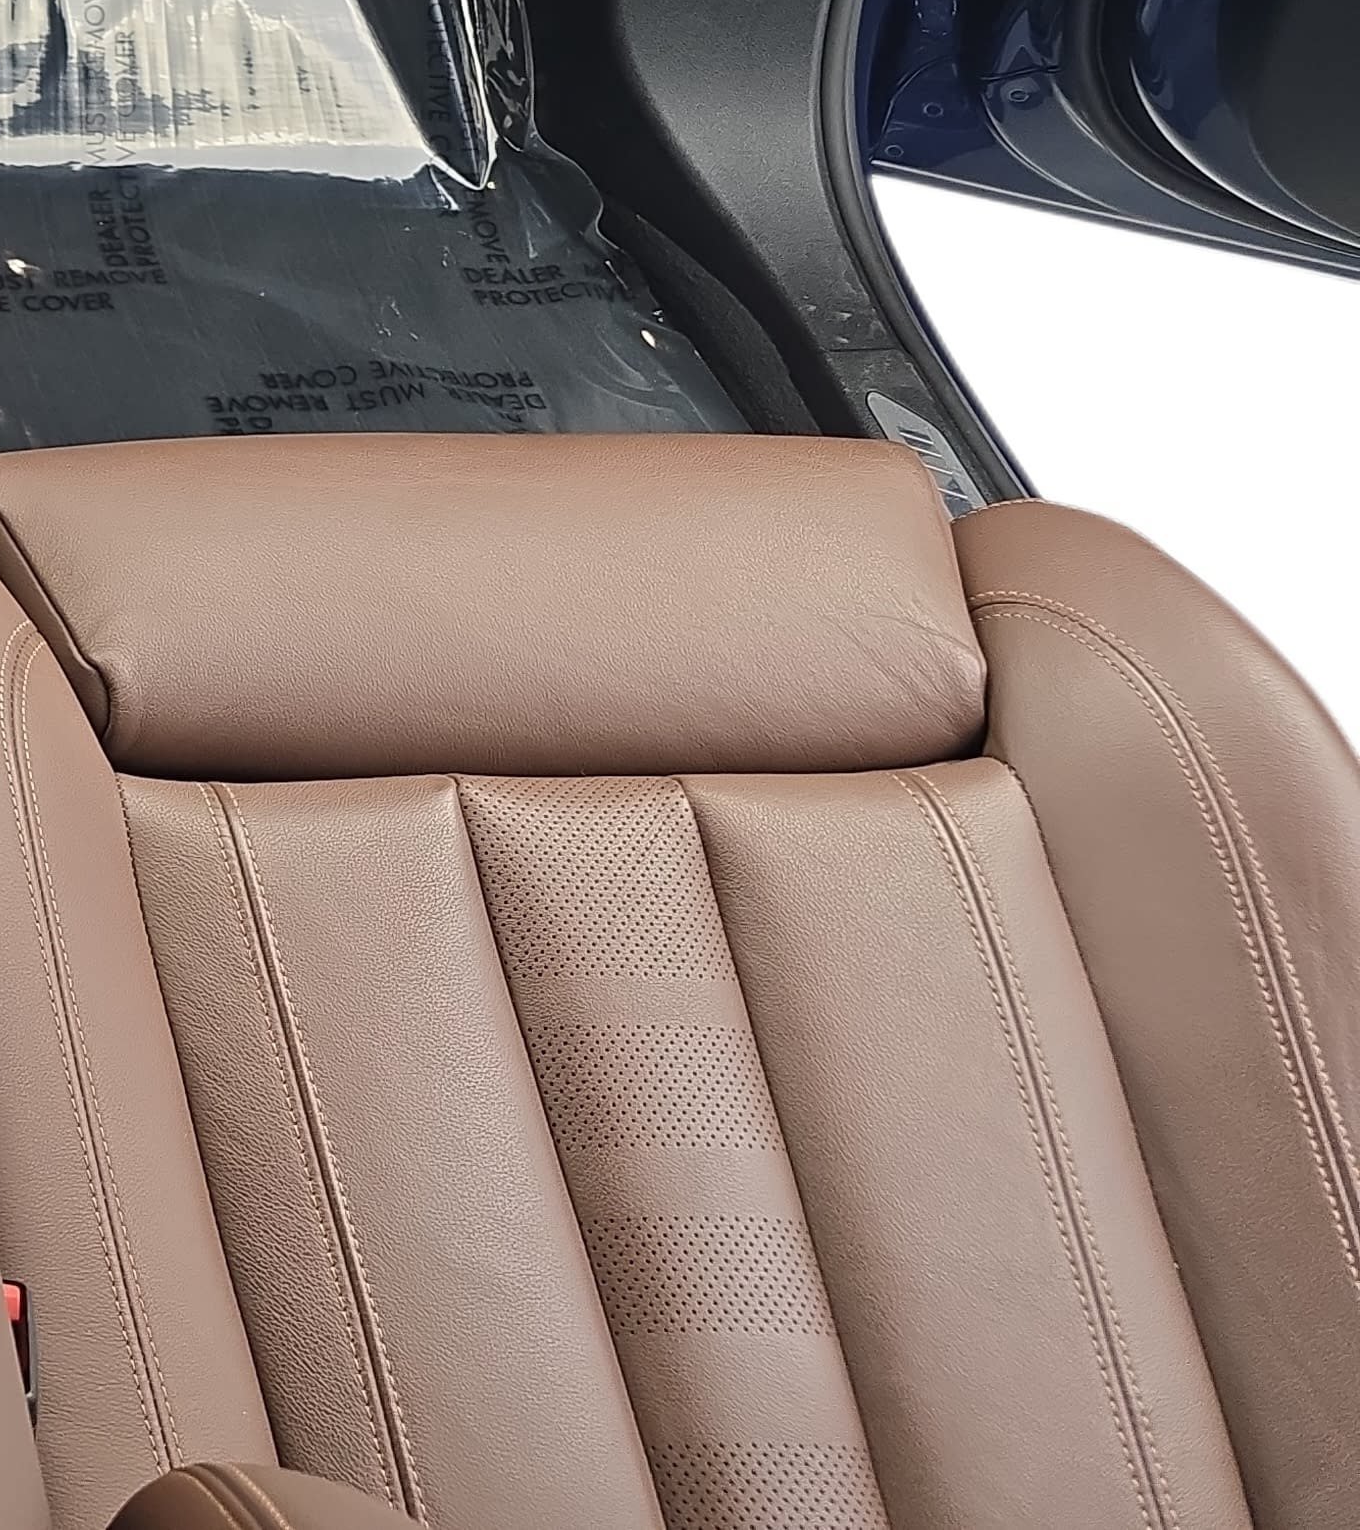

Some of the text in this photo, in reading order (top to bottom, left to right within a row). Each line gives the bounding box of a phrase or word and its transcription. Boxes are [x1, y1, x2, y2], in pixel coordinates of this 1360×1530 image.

[462, 264, 566, 285] DEALER
[23, 292, 115, 312] COVER
[259, 365, 359, 391] COVER
[205, 393, 330, 414] REMOVE
[346, 381, 425, 412] MUST
